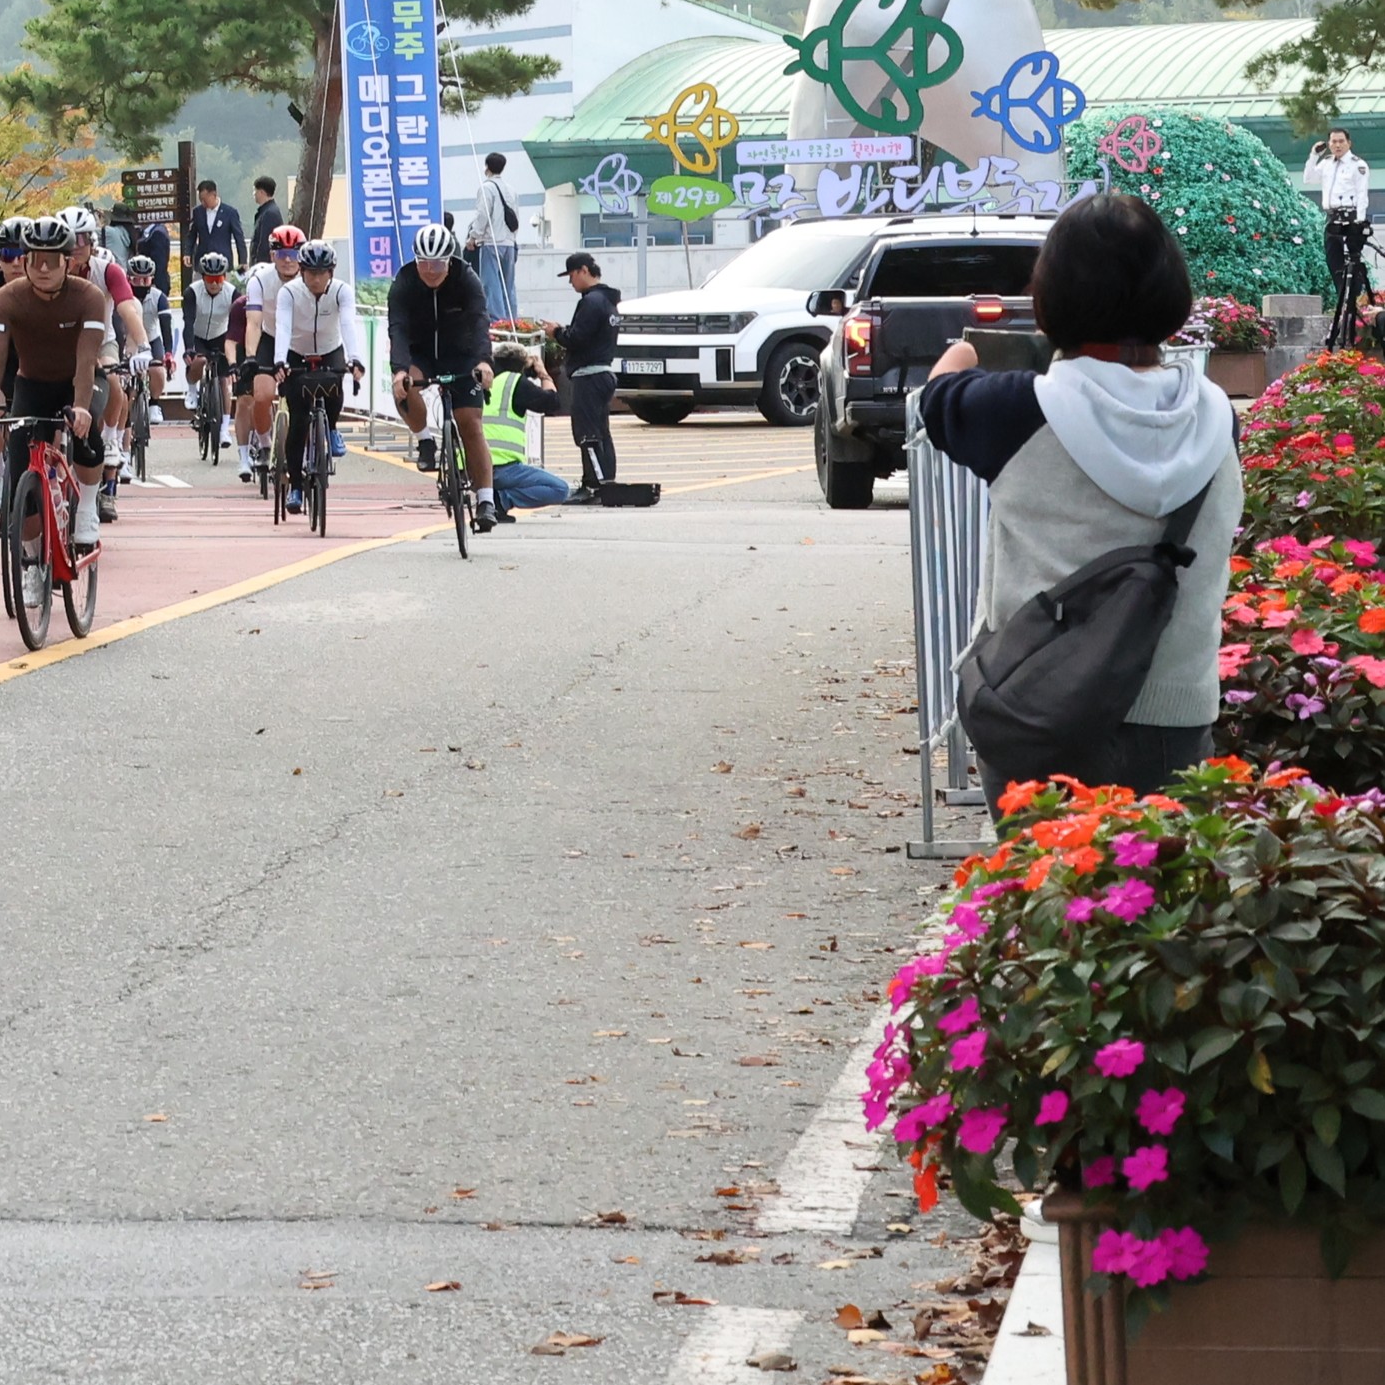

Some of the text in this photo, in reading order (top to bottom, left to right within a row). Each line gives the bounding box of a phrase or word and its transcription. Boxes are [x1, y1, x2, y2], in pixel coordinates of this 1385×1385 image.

[392, 0, 432, 228] 무주 그란폰도
[746, 139, 903, 164] 자연특별시 무주로의 힐링여행
[357, 73, 396, 279] 메디오폰도 대회
[654, 187, 722, 209] 제29회
